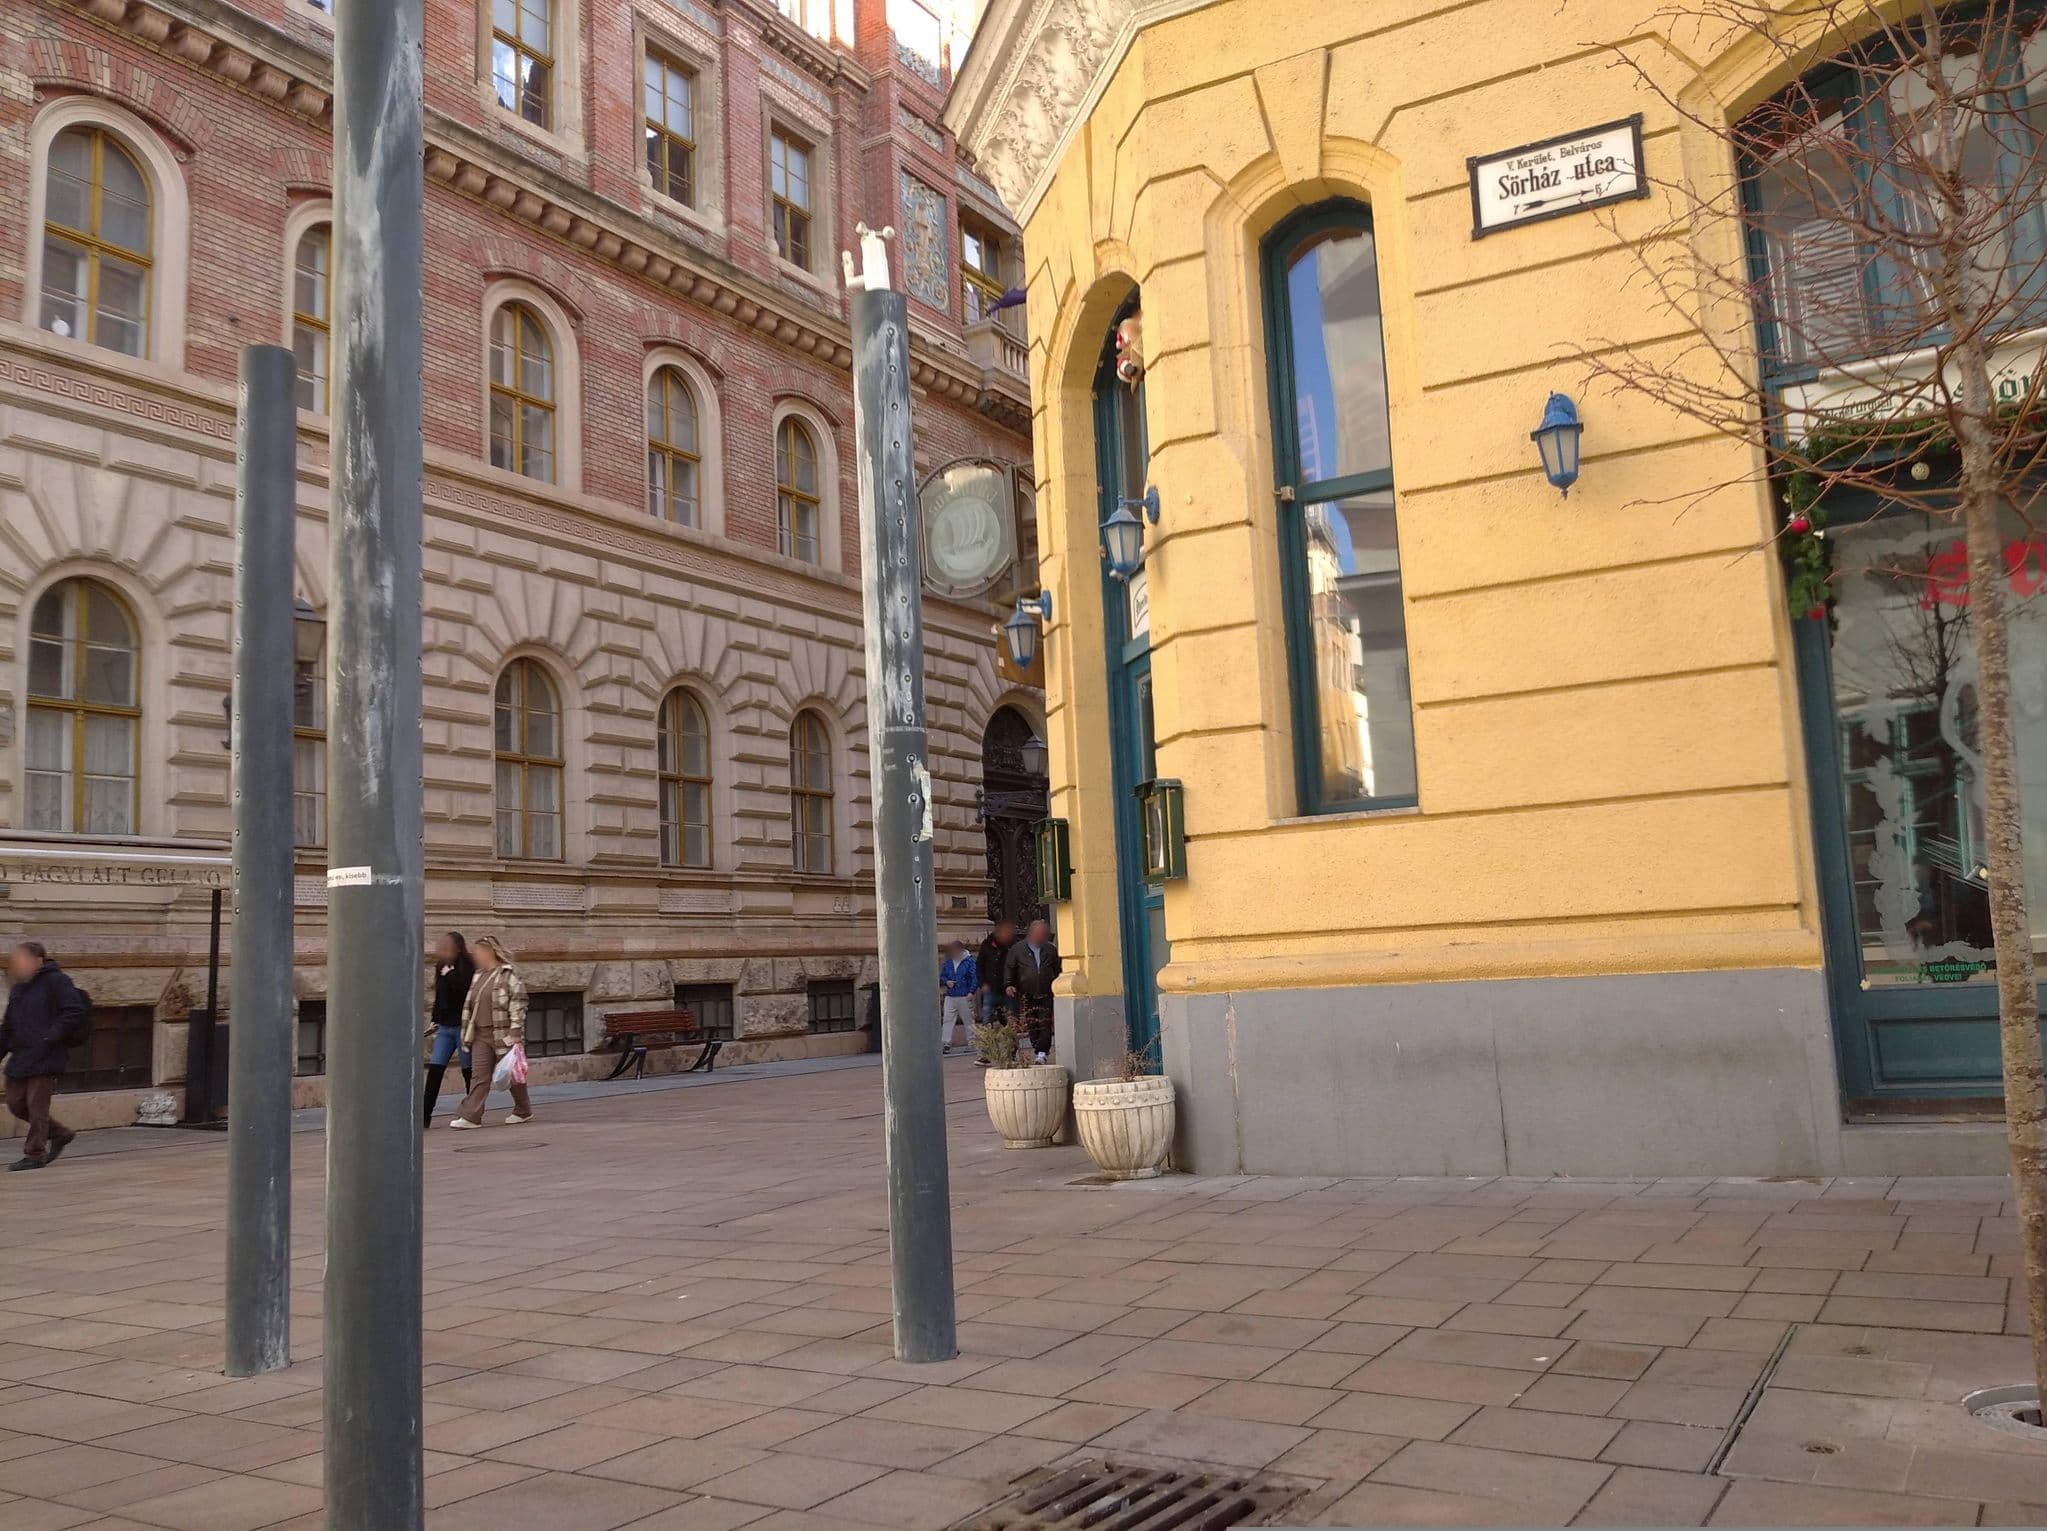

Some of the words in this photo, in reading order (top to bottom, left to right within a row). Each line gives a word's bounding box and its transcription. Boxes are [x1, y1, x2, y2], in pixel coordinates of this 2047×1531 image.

[1506, 160, 1514, 172] V.
[1560, 141, 1603, 158] Belváros
[1498, 167, 1561, 200] Sörház
[1574, 154, 1616, 180] utca
[1513, 203, 1520, 216] 7
